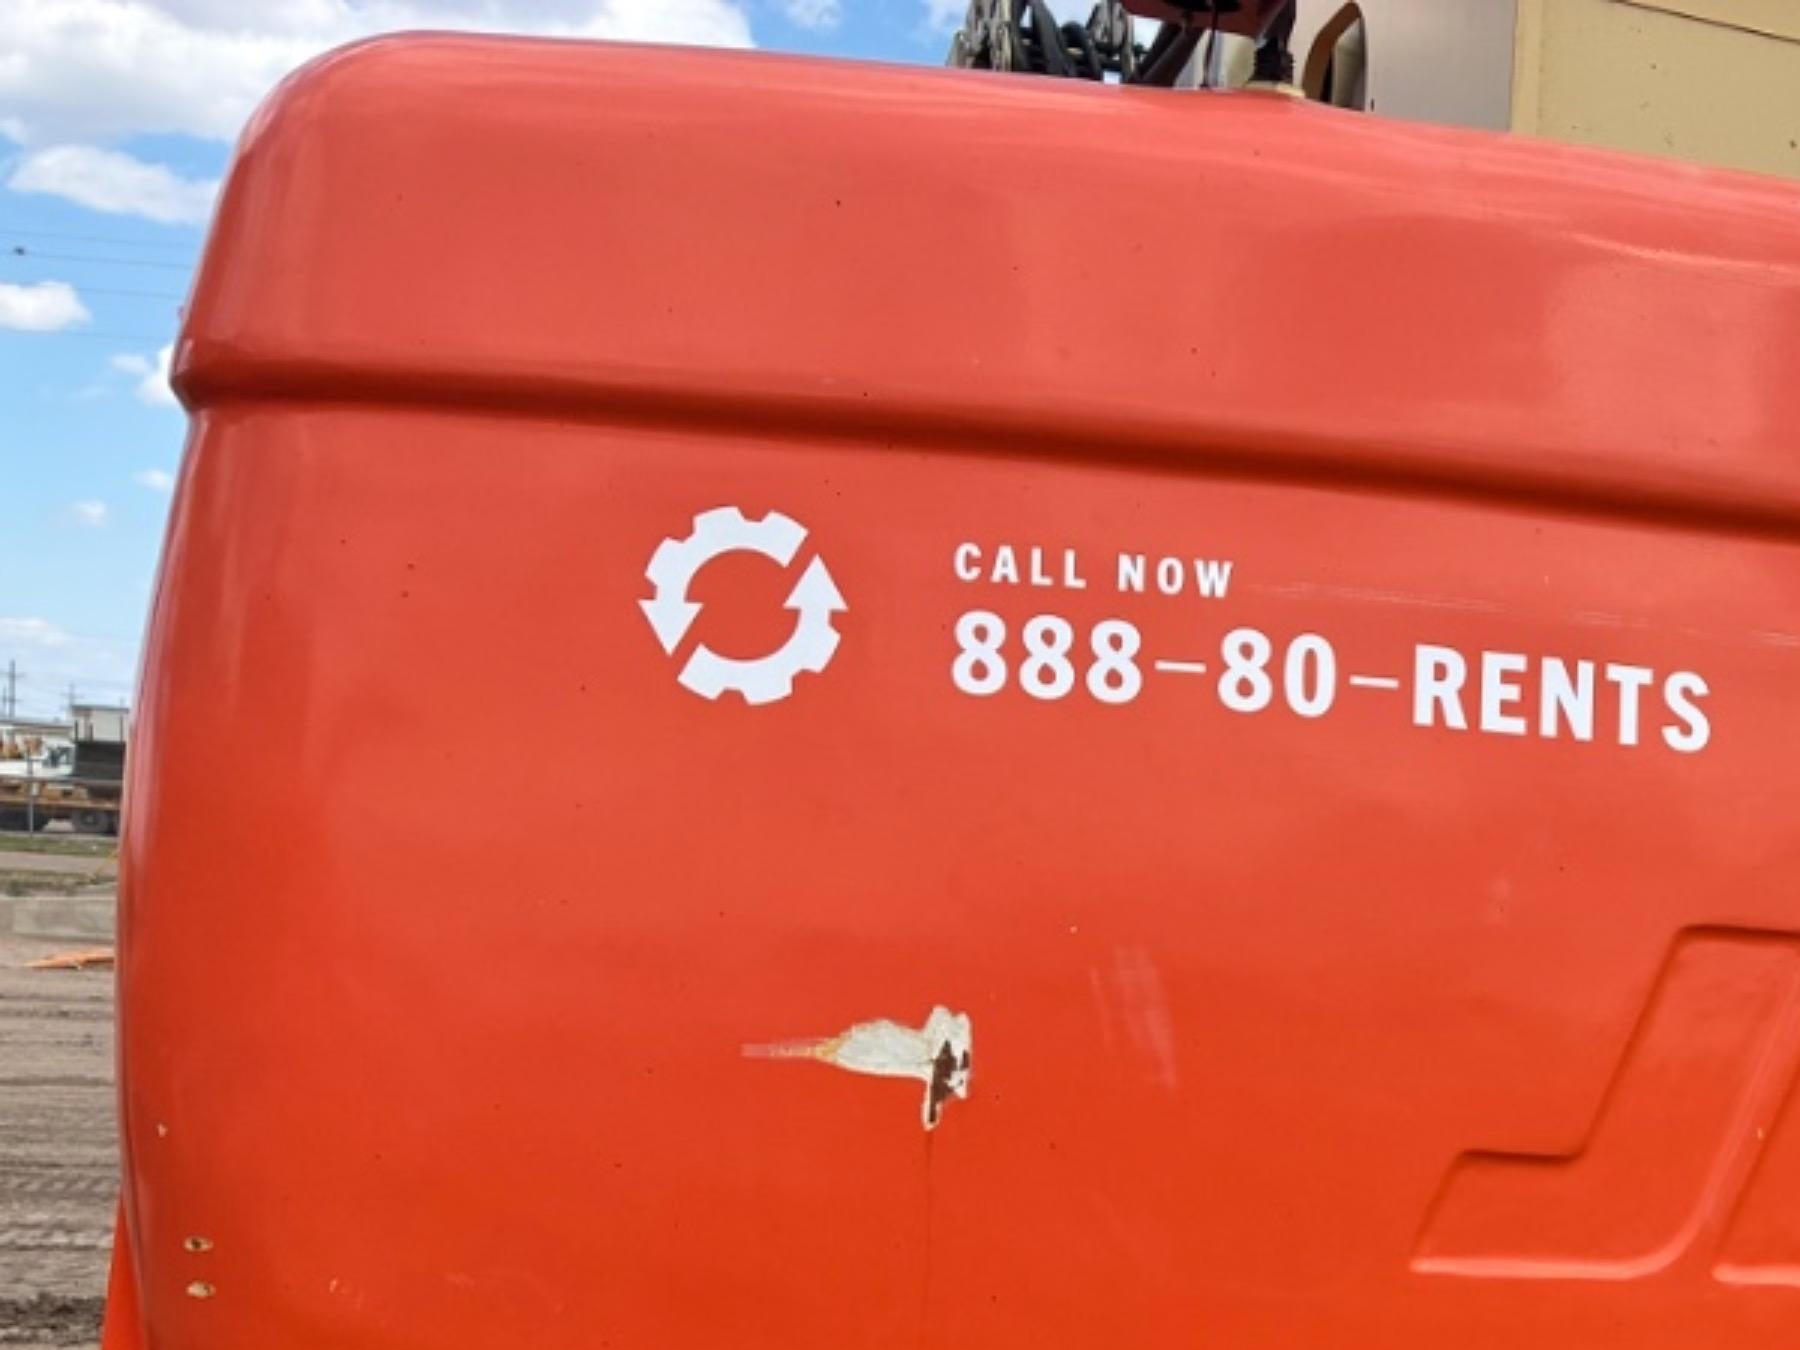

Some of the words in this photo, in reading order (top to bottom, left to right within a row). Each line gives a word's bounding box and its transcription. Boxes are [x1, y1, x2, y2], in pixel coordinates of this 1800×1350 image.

[953, 542, 1087, 588] CALL
[1116, 553, 1234, 599] NOW
[950, 609, 1712, 753] 888-80-RENTS
